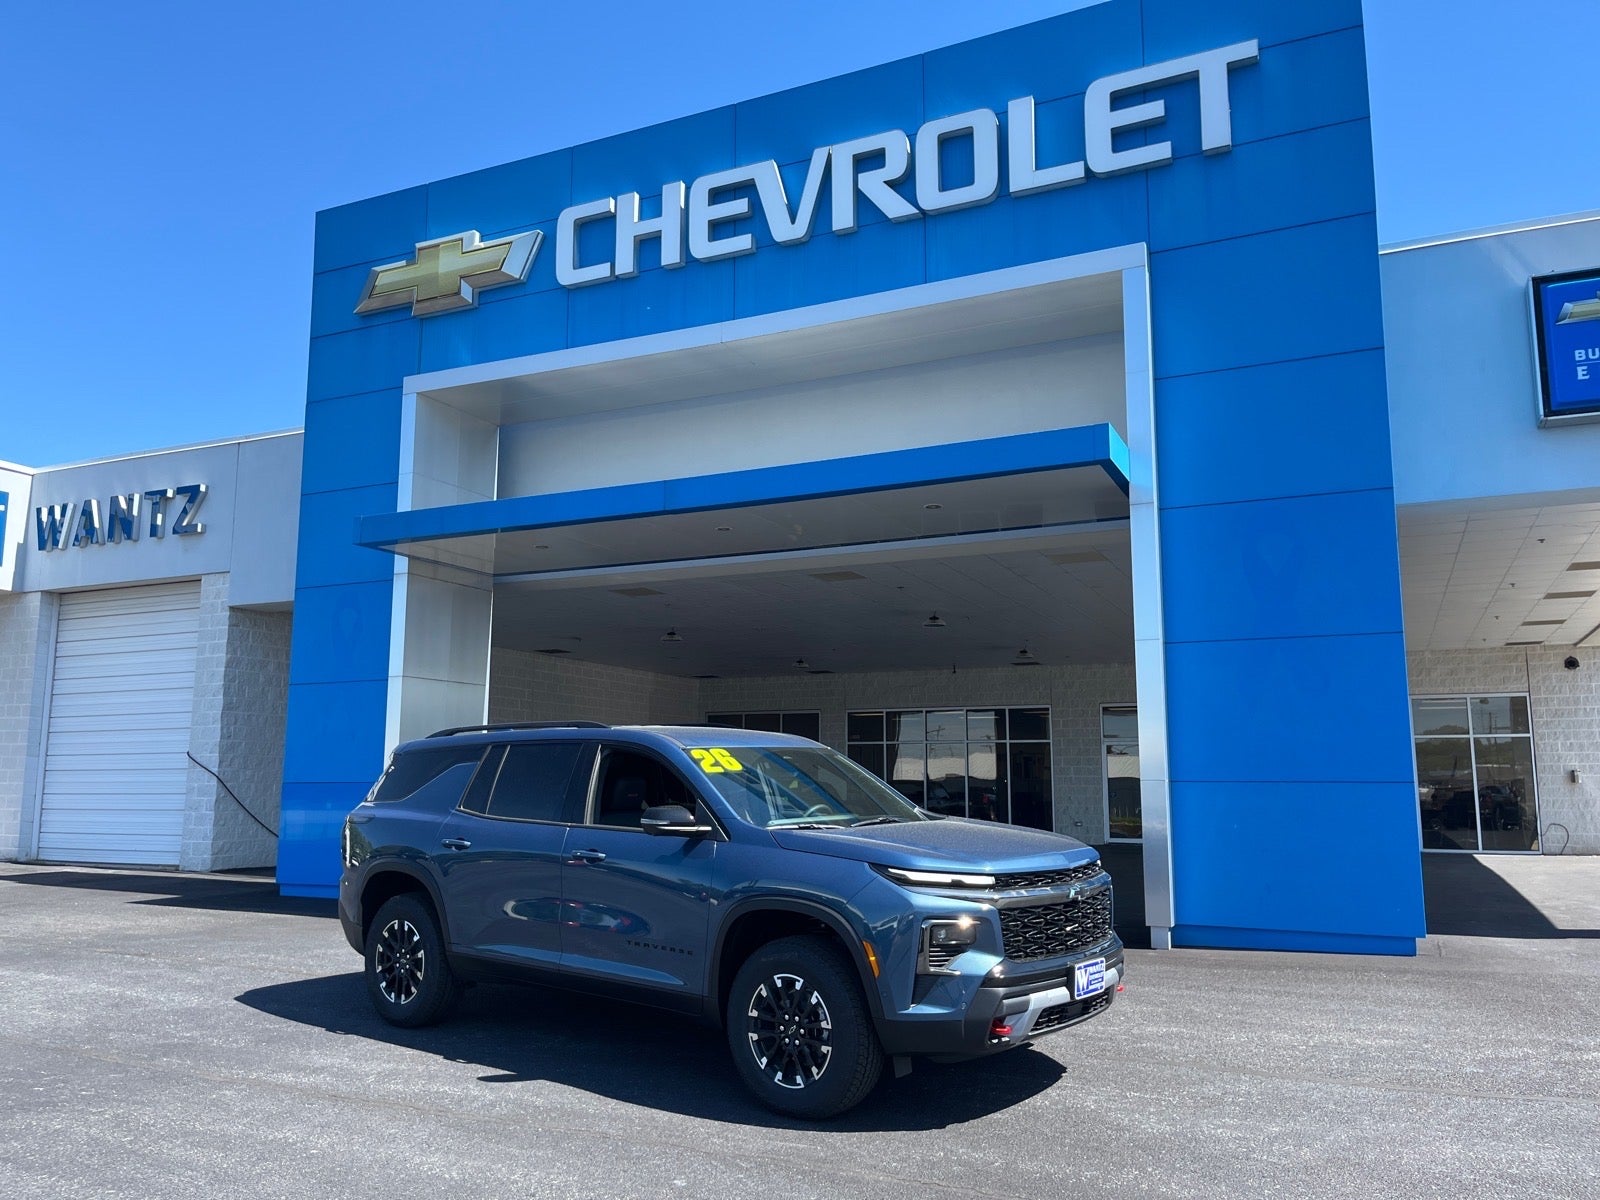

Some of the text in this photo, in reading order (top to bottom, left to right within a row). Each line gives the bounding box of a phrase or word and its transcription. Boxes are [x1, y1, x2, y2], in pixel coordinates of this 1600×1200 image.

[556, 39, 1259, 288] CHEVROLET
[36, 484, 209, 552] WANTZ
[690, 748, 743, 773] 26
[626, 940, 694, 956] TRAVERSE
